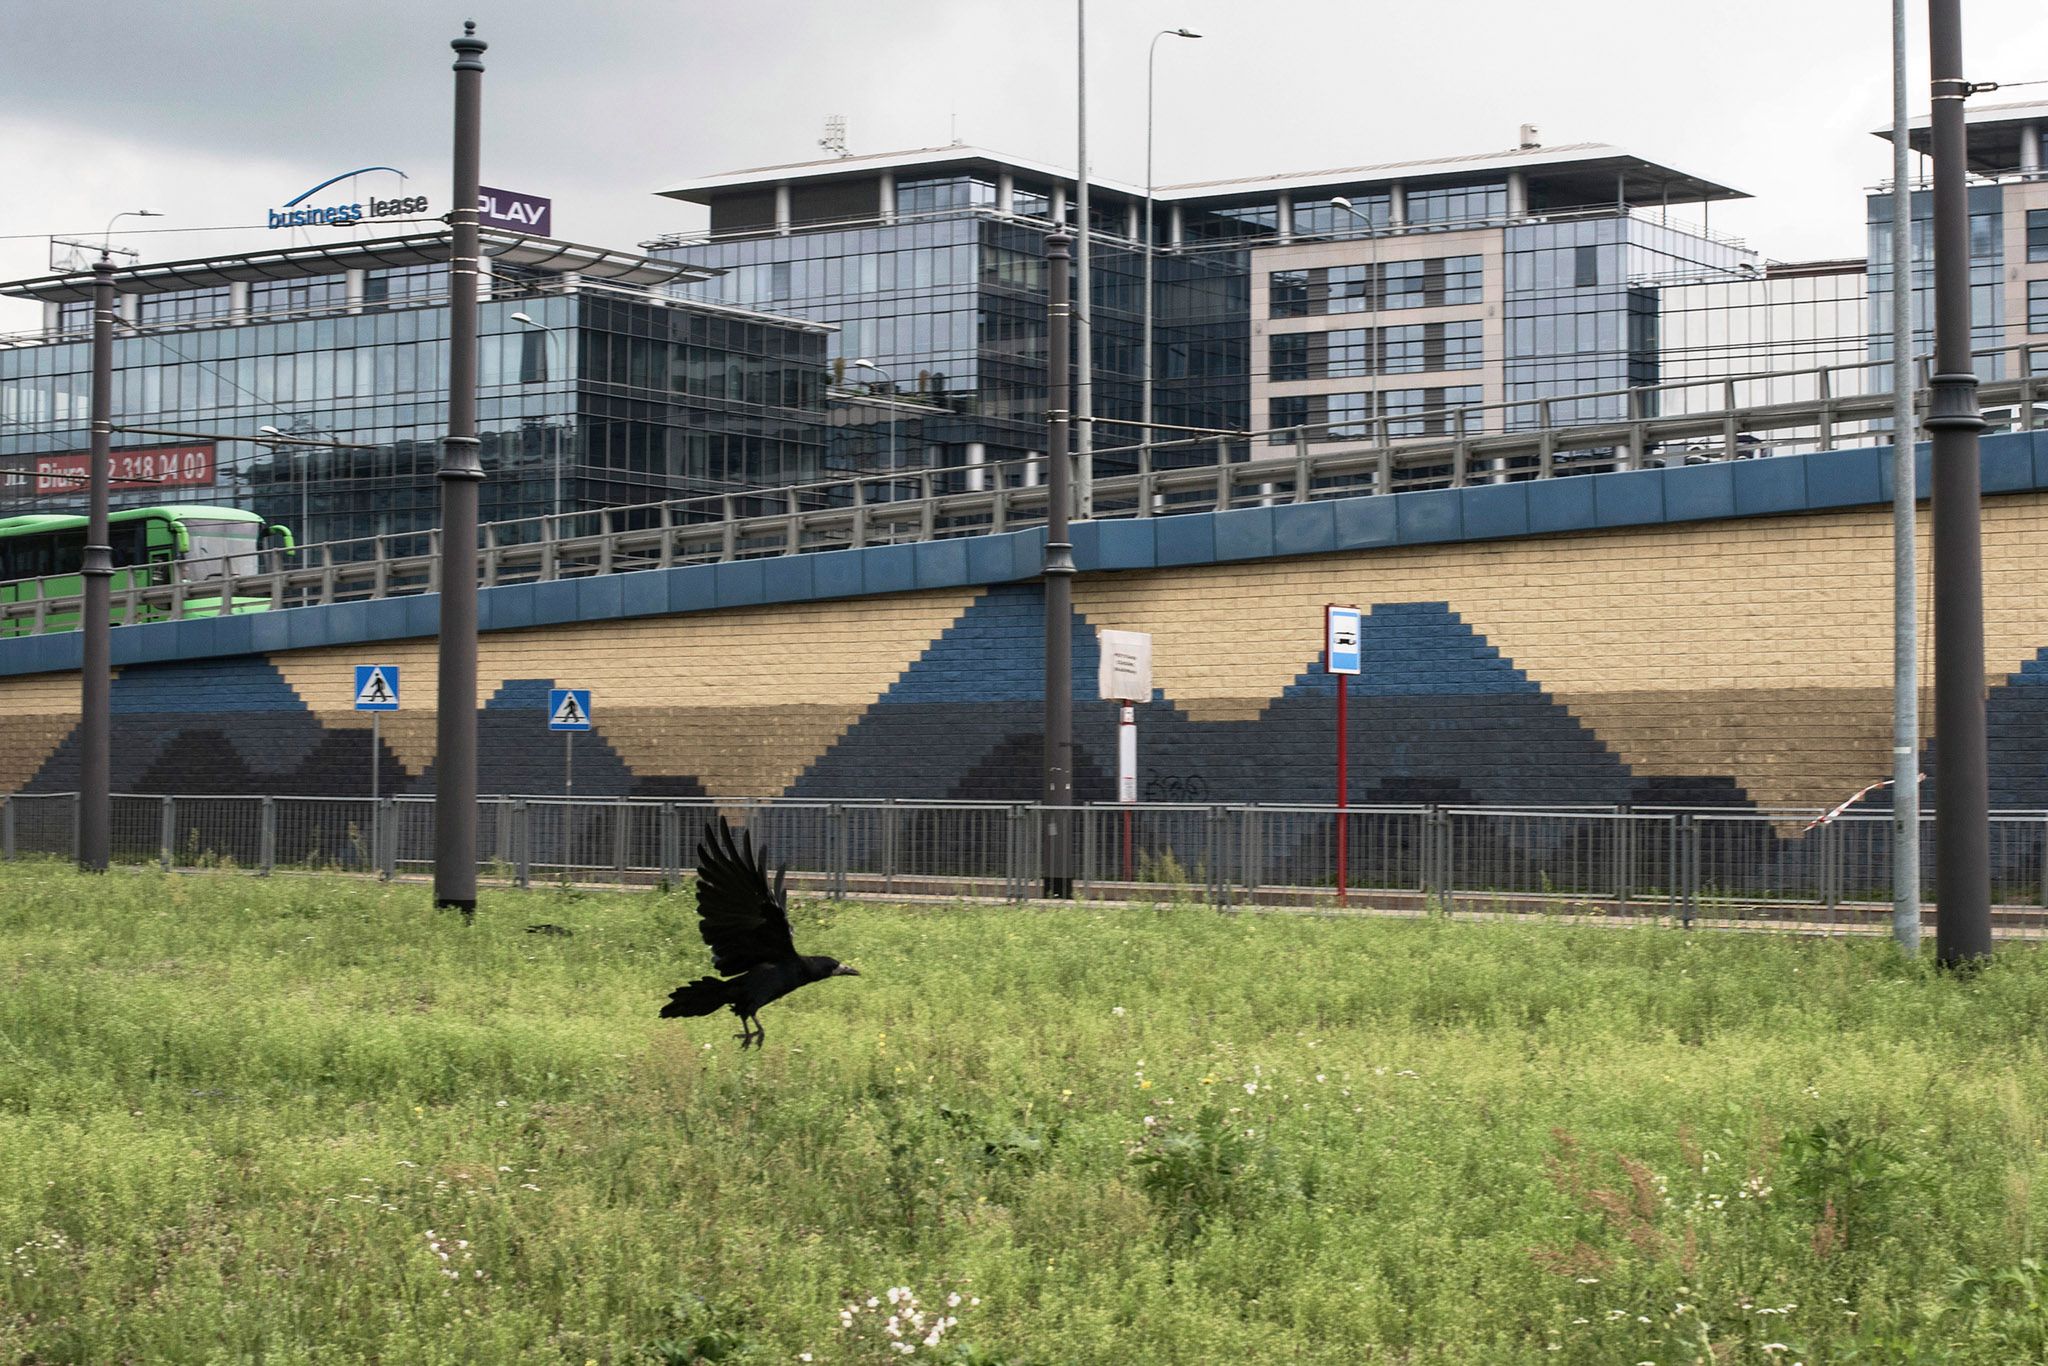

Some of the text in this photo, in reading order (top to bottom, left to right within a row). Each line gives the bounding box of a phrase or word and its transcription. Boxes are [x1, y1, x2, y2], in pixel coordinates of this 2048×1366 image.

[269, 195, 428, 229] business lease
[478, 194, 546, 225] PLAY
[122, 455, 154, 483] 318
[183, 451, 206, 479] 00
